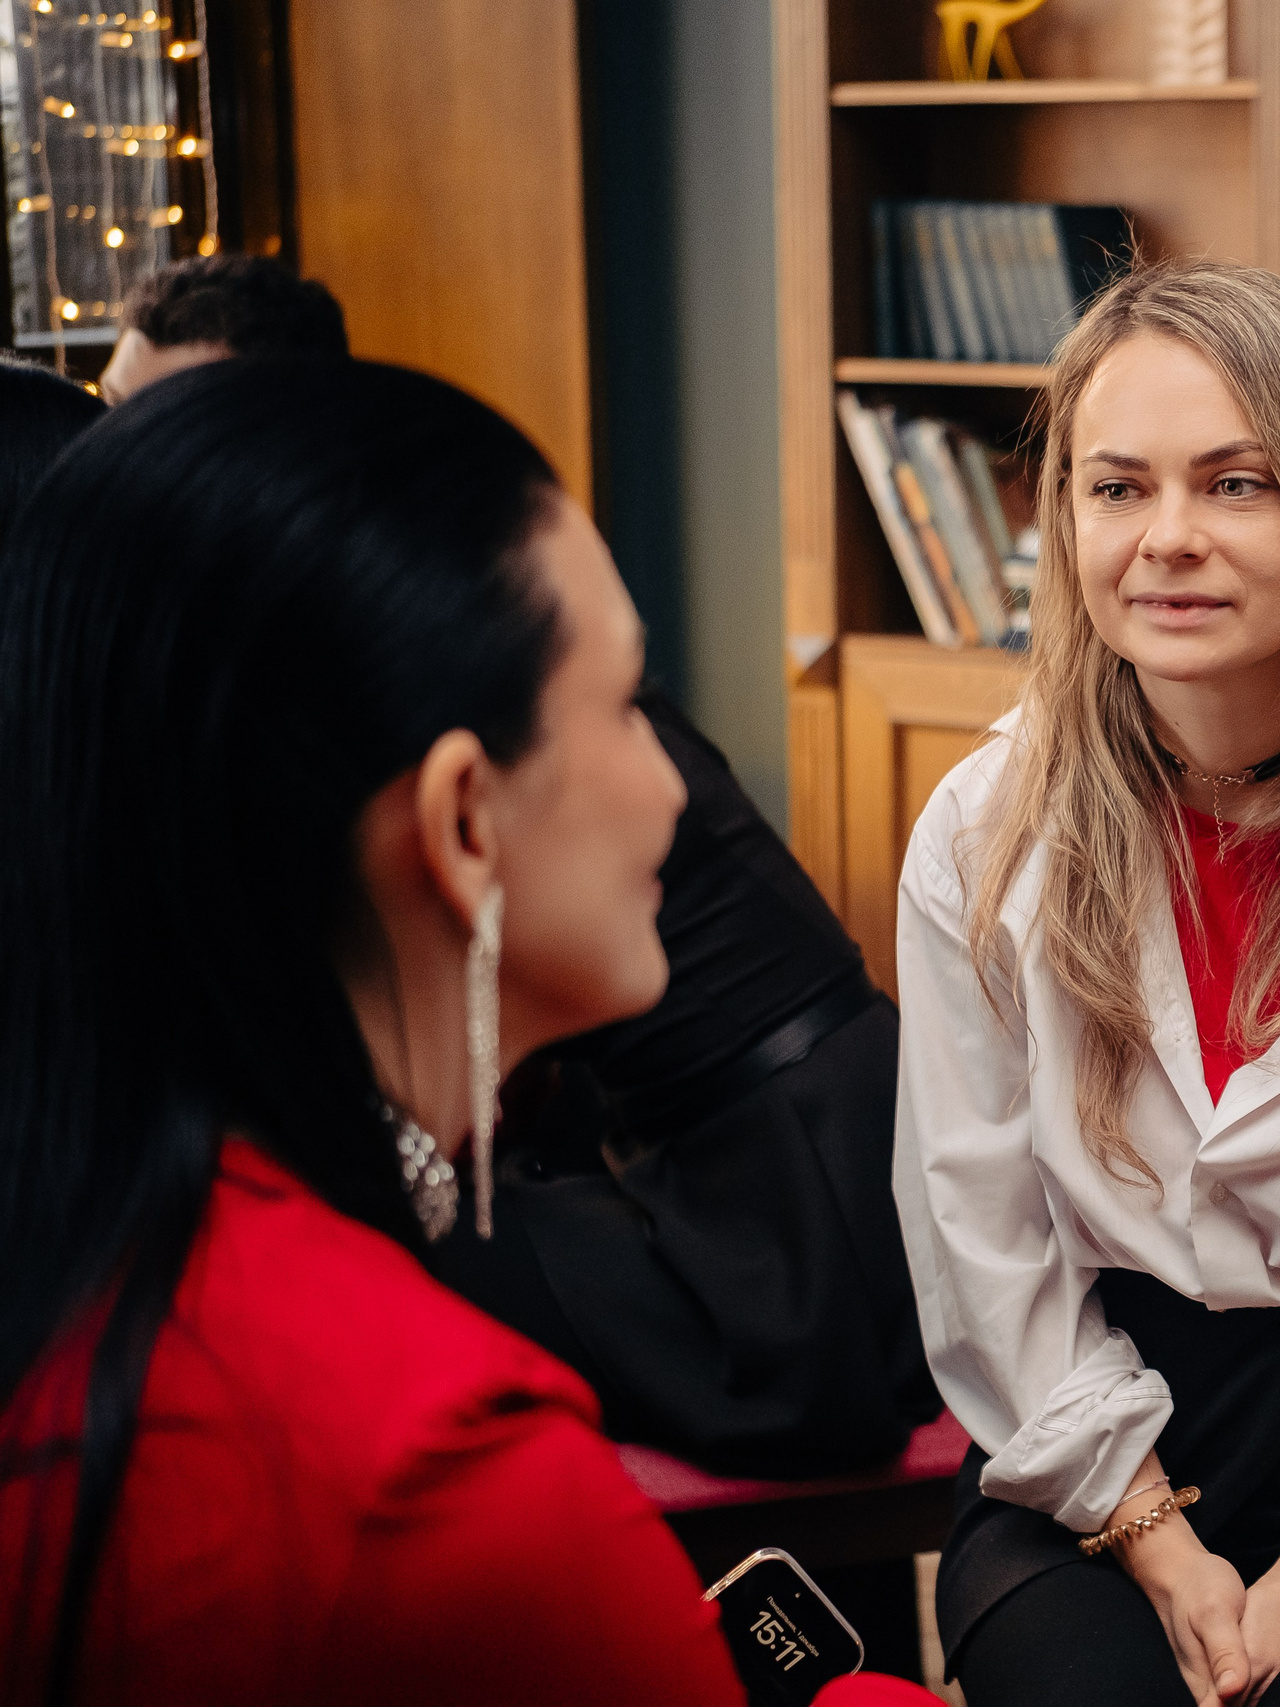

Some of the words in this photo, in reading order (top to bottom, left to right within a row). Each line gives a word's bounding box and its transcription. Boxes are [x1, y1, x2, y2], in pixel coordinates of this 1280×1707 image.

[749, 1610, 806, 1671] 15:11
[766, 1596, 797, 1633] Понедельник,
[798, 1635, 819, 1656] декабря
